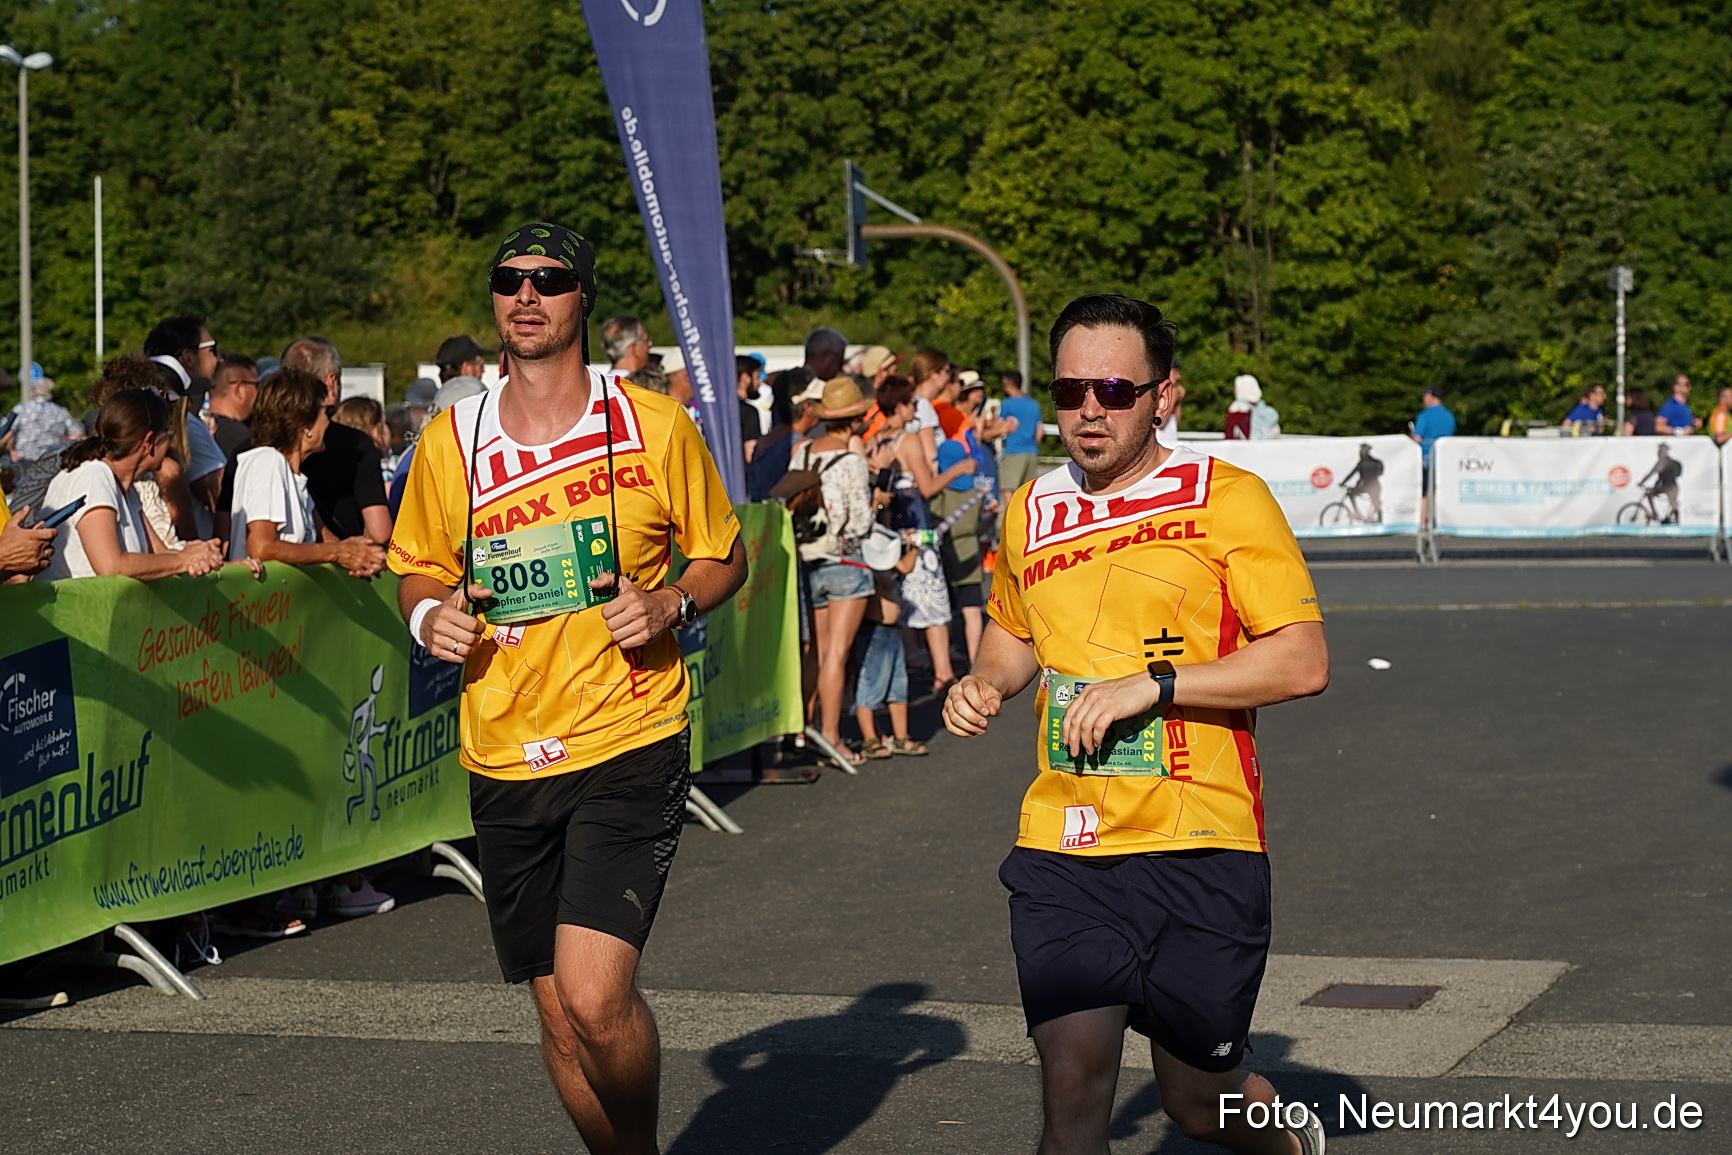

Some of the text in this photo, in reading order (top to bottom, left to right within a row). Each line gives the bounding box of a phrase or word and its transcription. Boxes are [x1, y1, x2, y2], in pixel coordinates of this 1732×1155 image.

[475, 465, 655, 538] MAX BÖGL
[491, 559, 550, 594] 808
[1024, 520, 1207, 592] MAX BÖGL
[529, 586, 564, 601] Daniel
[561, 558, 578, 599] 2022
[137, 592, 291, 673] Gesunde Firmen
[176, 624, 303, 720] laufen länger!
[7, 688, 57, 723] Fischer
[13, 710, 54, 736] AUTOMOBILE
[1052, 718, 1060, 751] RUN
[1143, 718, 1155, 762] 2022
[386, 767, 439, 810] neumarkt
[93, 824, 305, 910] www.firmenlauf-oberpfalz.de
